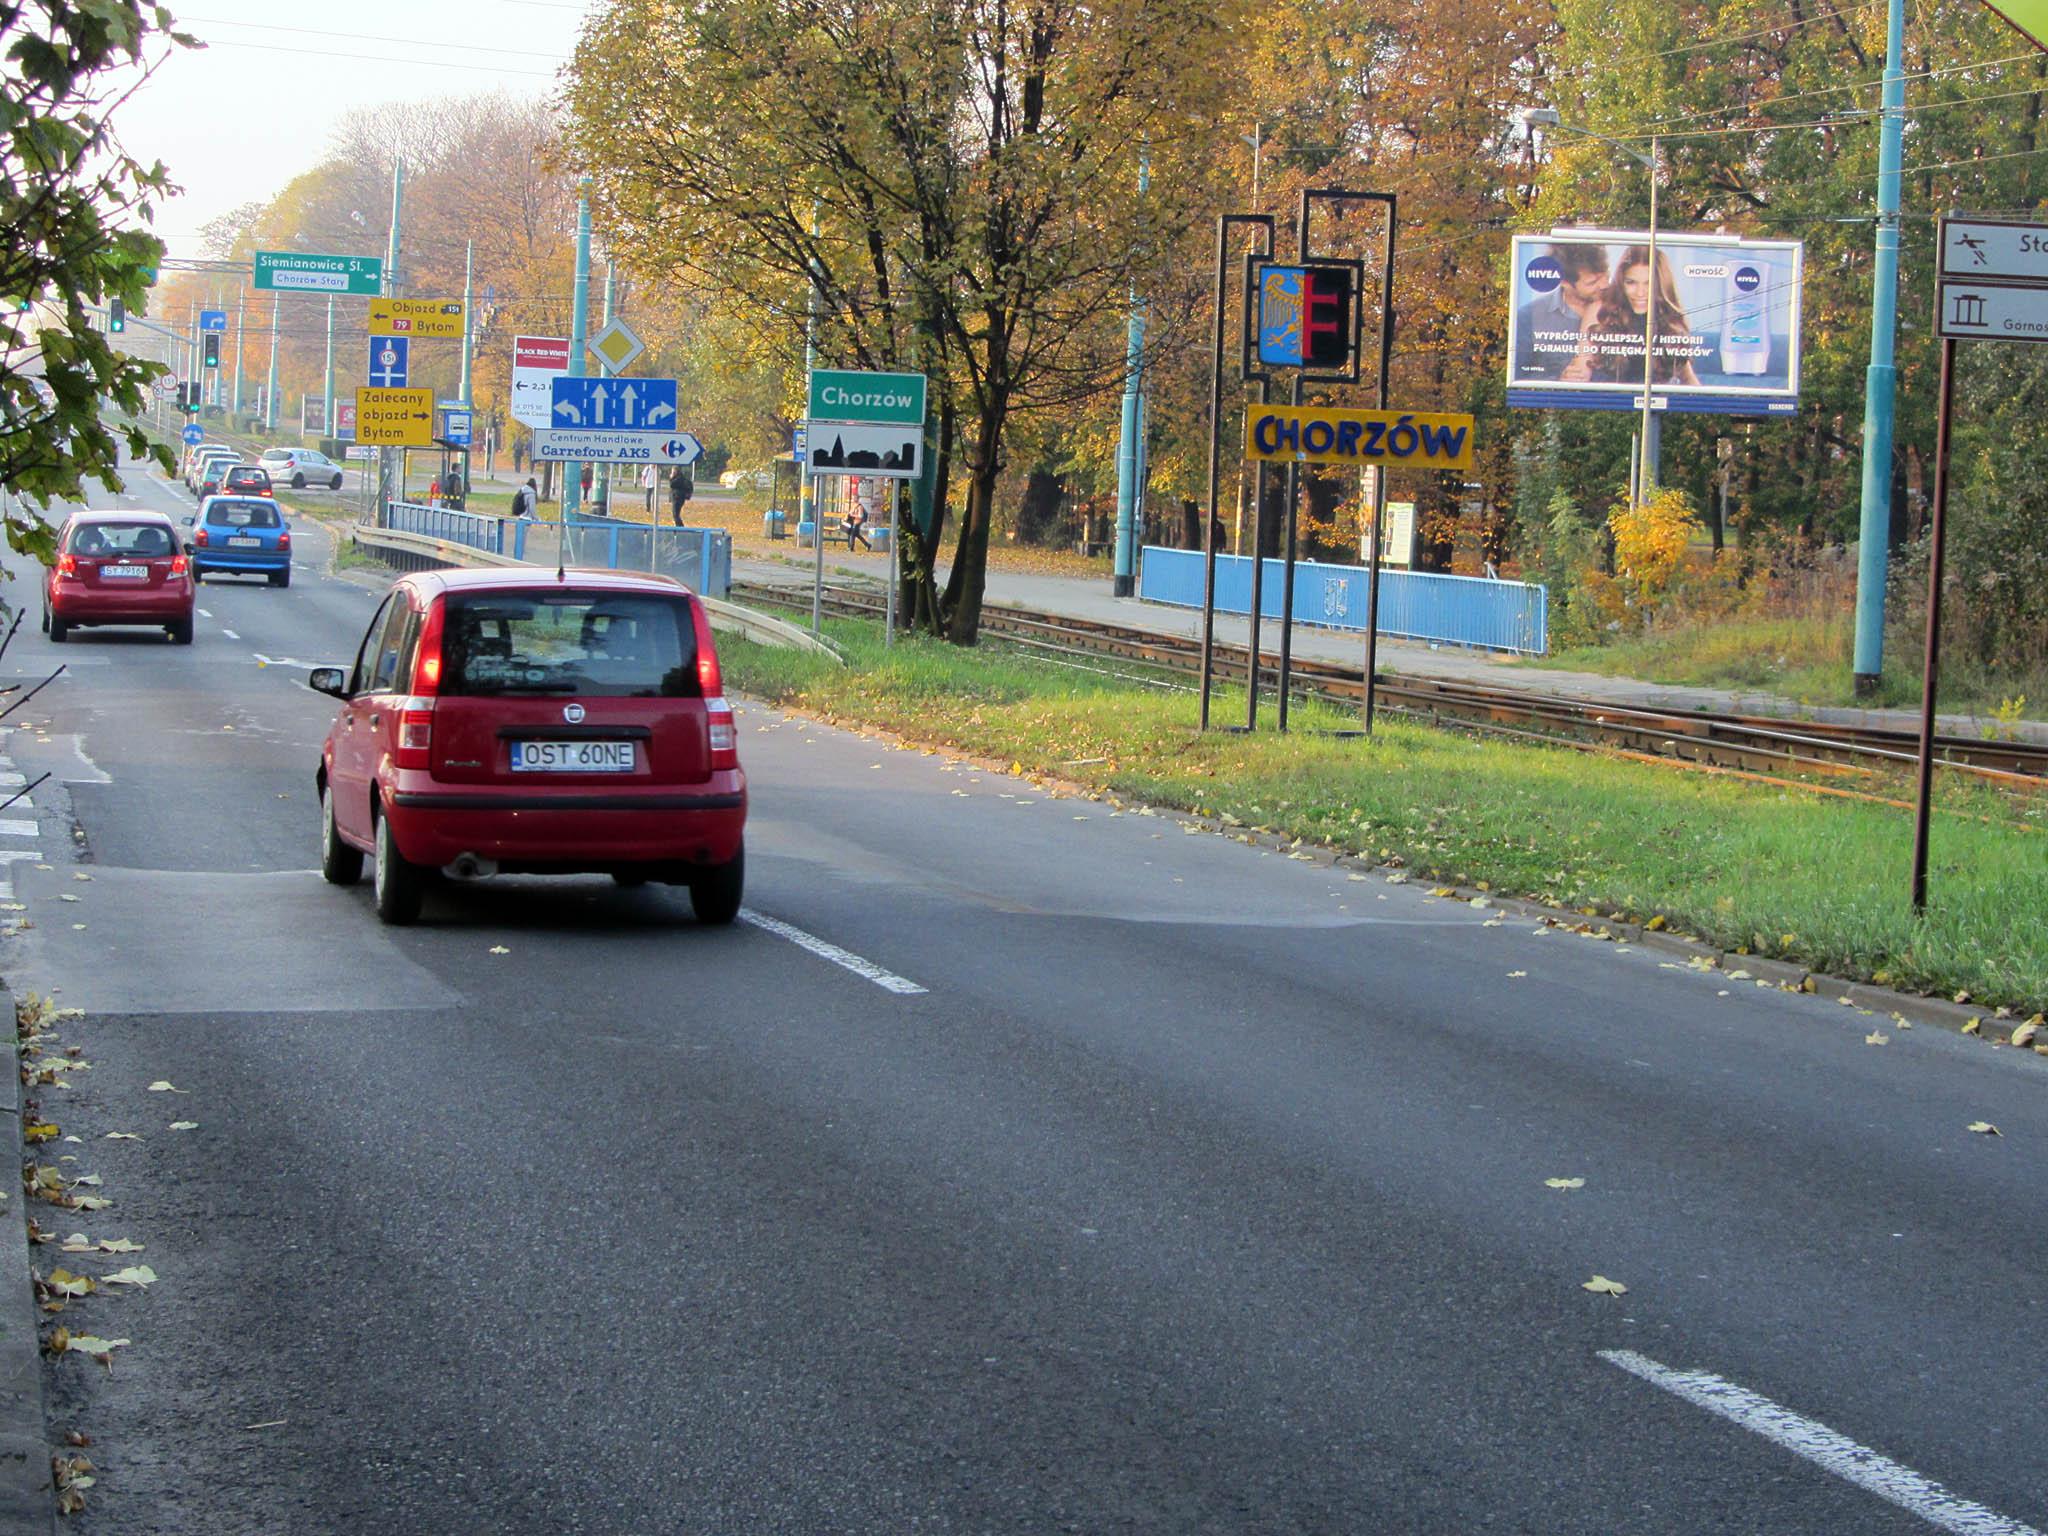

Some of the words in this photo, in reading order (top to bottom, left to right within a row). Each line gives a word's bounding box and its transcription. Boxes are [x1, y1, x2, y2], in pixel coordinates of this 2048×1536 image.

[260, 255, 345, 271] Siemianowice
[349, 257, 364, 272] Śl.
[1527, 269, 1560, 279] NIVEA
[320, 275, 345, 287] Stary
[392, 302, 436, 315] Objazd
[396, 320, 408, 329] 79
[417, 320, 455, 333] Bytom
[1659, 335, 1704, 345] HISTORII
[536, 348, 549, 356] RED
[1583, 345, 1599, 354] DO
[363, 391, 424, 407] Zalecany
[821, 386, 913, 408] Chorzów
[363, 408, 409, 423] objazd
[363, 426, 404, 441] Bytom
[550, 432, 592, 443] Centrum
[594, 434, 644, 444] Handlowe
[1254, 413, 1468, 458] CHORZÓW
[541, 445, 614, 457] Carrefour
[617, 447, 650, 458] AKS
[525, 744, 571, 765] OST
[578, 744, 631, 765] 60NE
